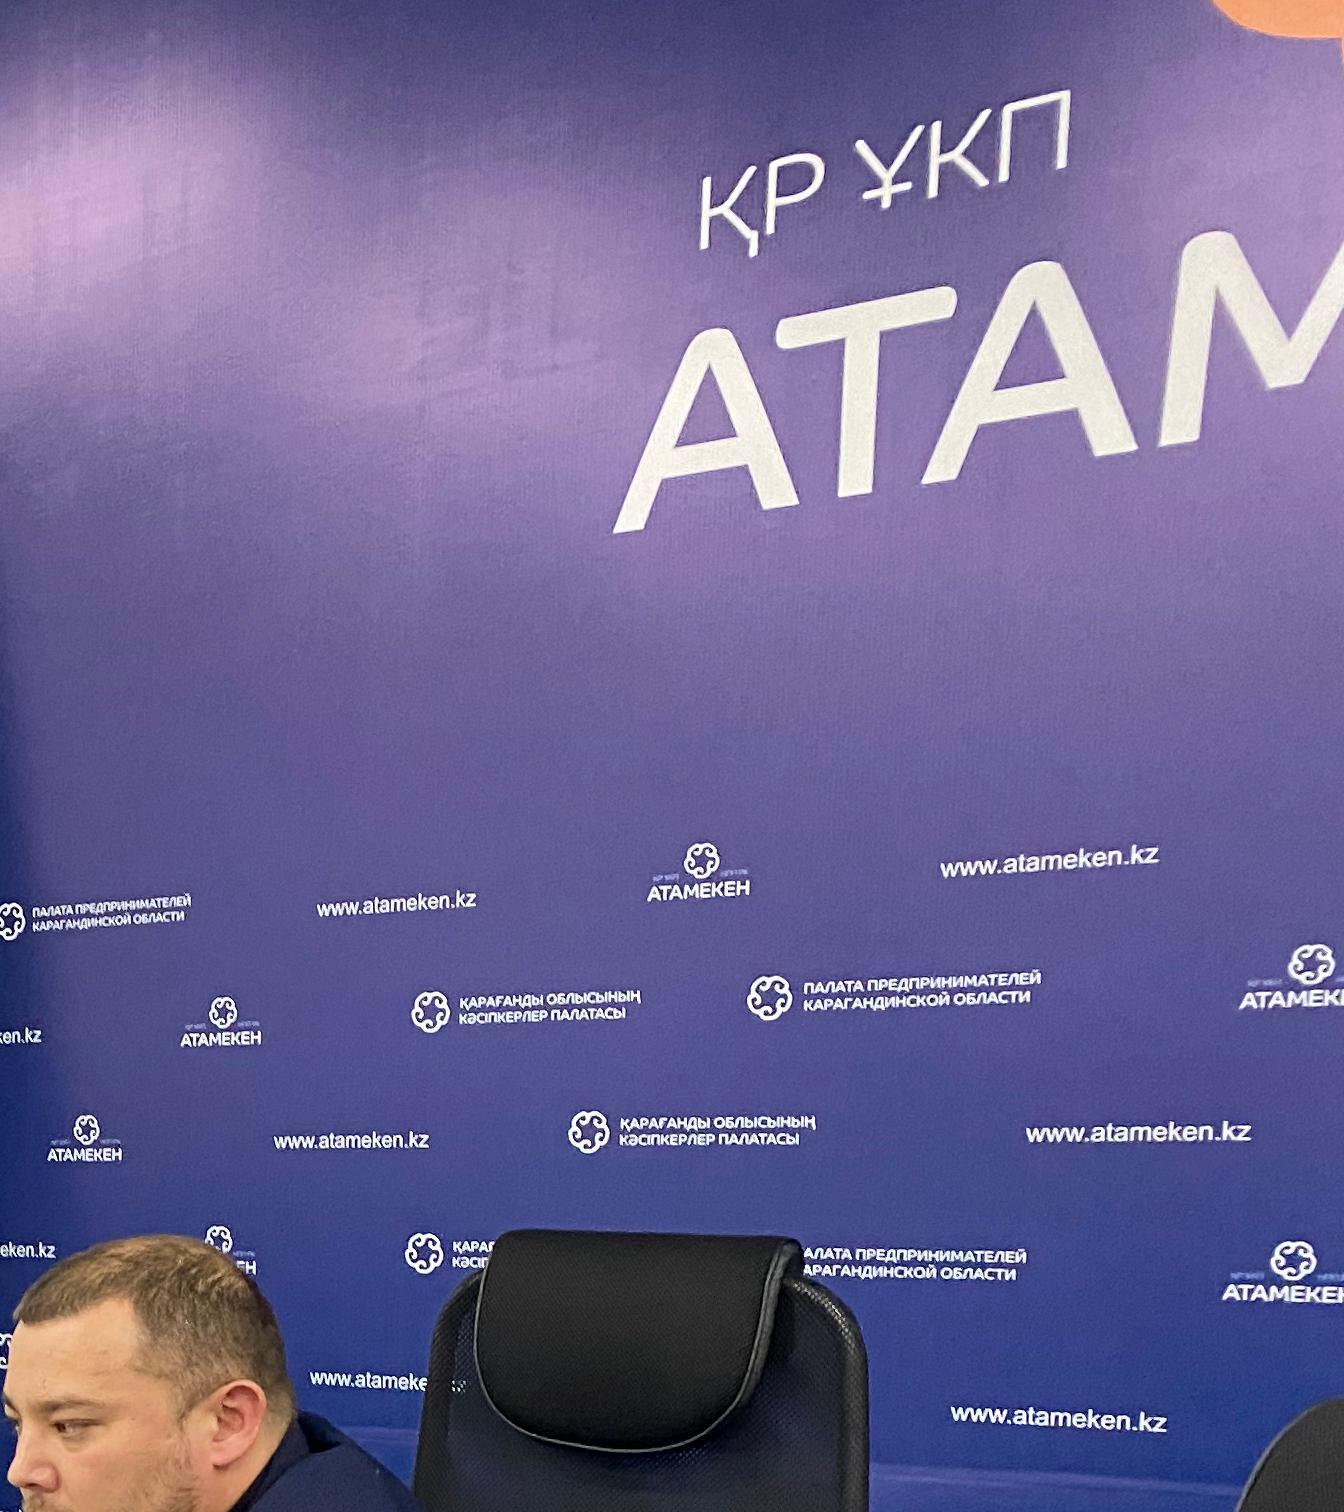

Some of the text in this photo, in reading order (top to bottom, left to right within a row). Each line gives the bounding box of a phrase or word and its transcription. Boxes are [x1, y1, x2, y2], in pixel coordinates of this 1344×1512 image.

[699, 89, 1071, 258] ҚР ҰКП
[613, 230, 1344, 534] АТАМ
[940, 844, 1160, 879] www.atameken.kz
[647, 880, 751, 902] АТАМЕКЕН
[32, 892, 192, 918] ПАЛАТА ПРЕДПРИНИМАТЕЛЕЙ
[317, 890, 477, 918] www.atameken.kz
[32, 910, 185, 932] КАРАГАНДИНСКОЙ ОБЛАСТИ
[803, 969, 1042, 995] ПАЛАТА ПРЕДПРИНИМАТЕЛЕЙ
[803, 989, 1031, 1012] КАРАГАНДИНСКОЙ ОБЛАСТИ
[1238, 989, 1344, 1010] АТАМЕК
[550, 1006, 627, 1022] ПАЛАТАСЫ
[180, 1030, 262, 1048] АТАМЕКЕН
[273, 1130, 430, 1150] www.atameken.kz
[718, 1132, 800, 1146] ПАЛАТАСЫ
[1025, 1120, 1252, 1144] www.atameken.kz
[47, 1147, 123, 1162] АТАМЕКЕН
[855, 1248, 1028, 1264] ПРЕДПРИНИМАТЕЛЕЙ
[939, 1267, 1017, 1281] ОБЛАСТИ
[950, 1405, 1167, 1434] www.atameken.kz
